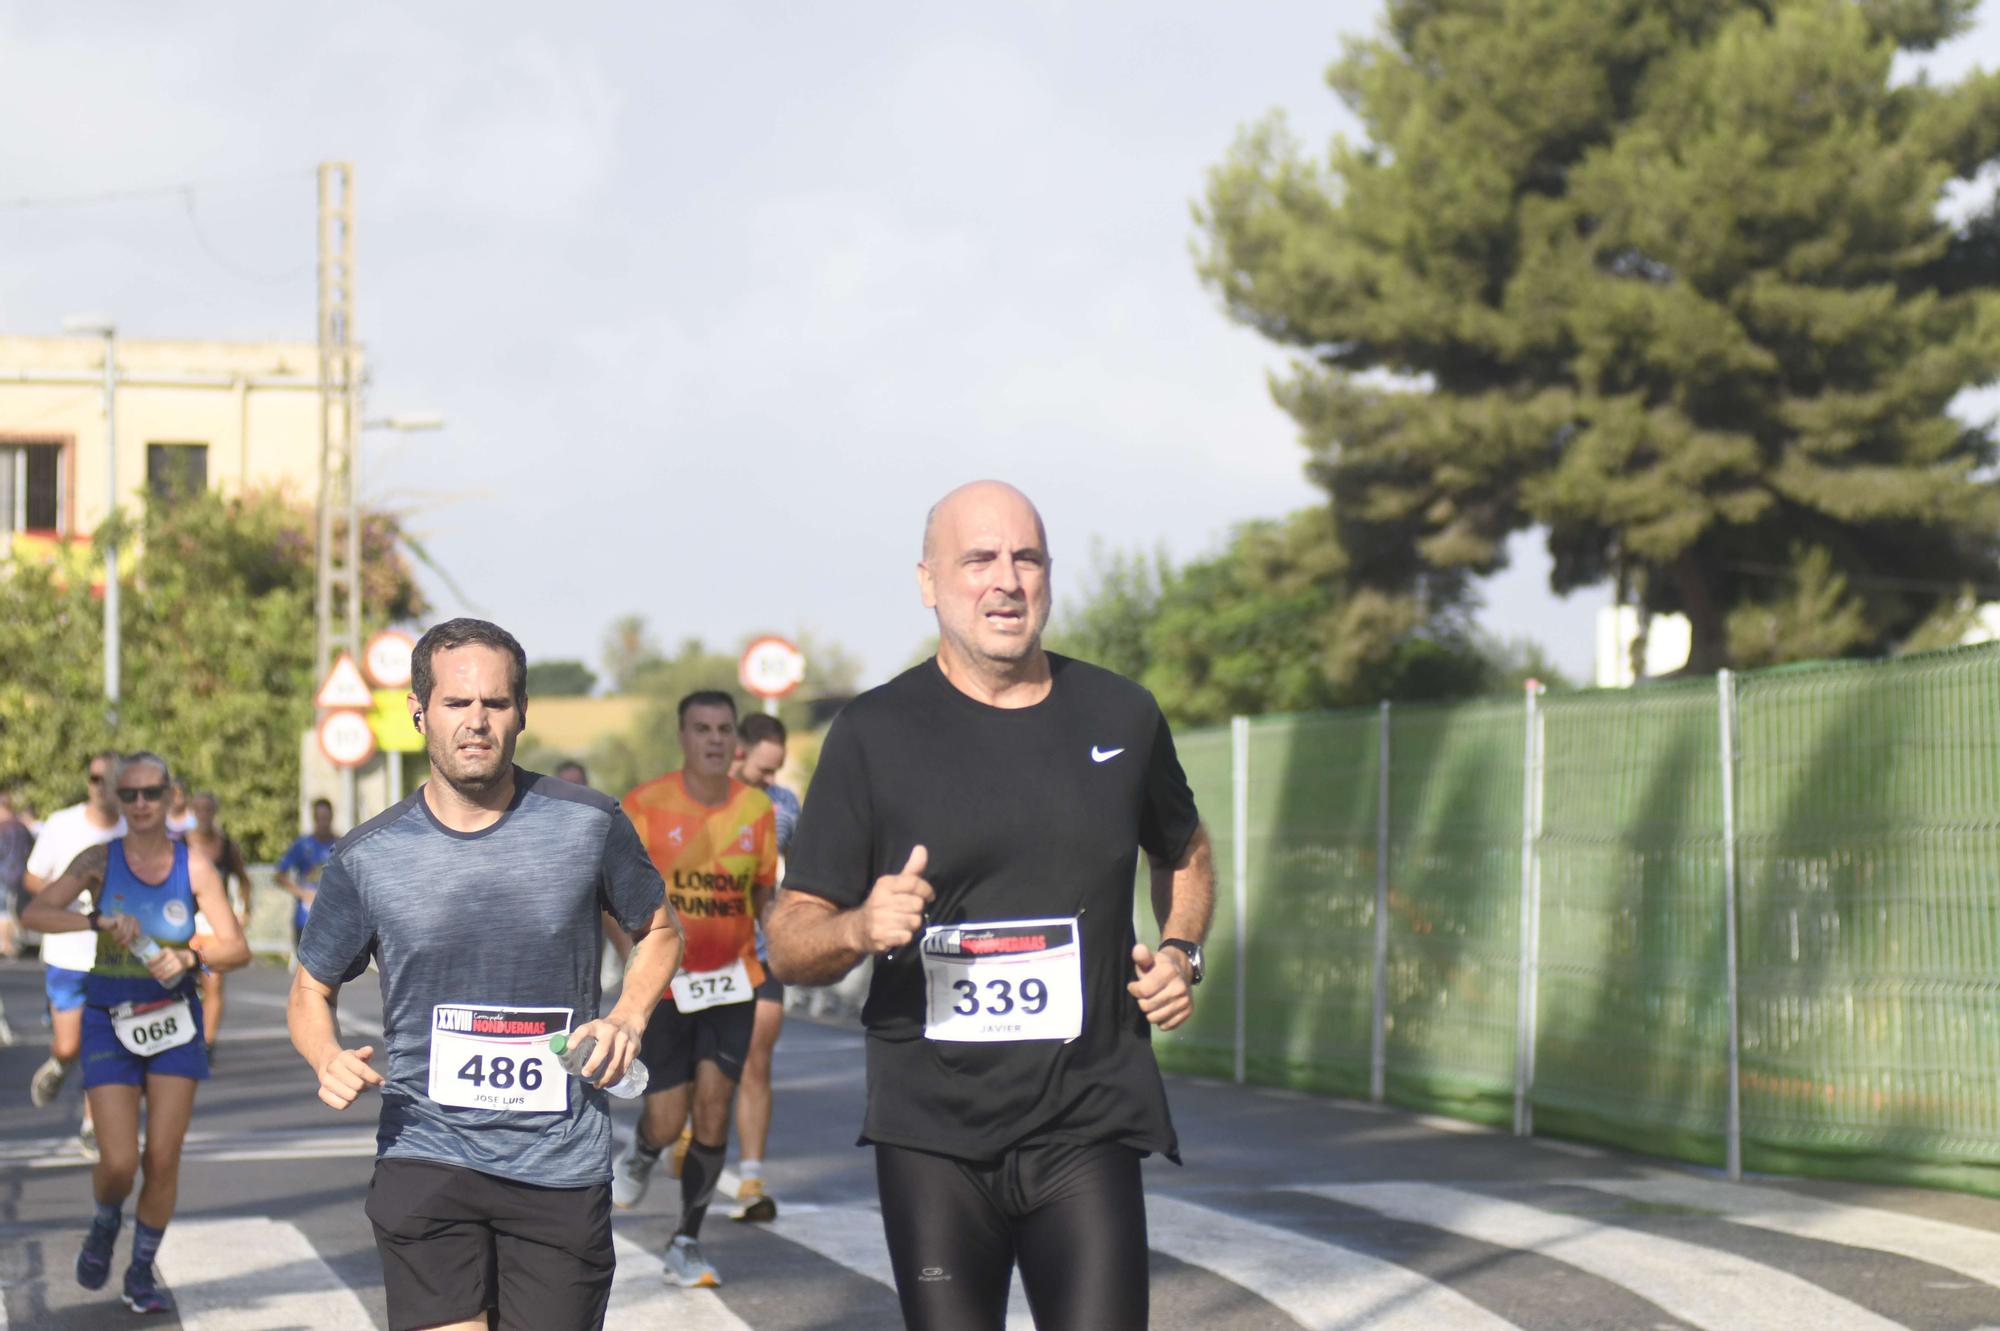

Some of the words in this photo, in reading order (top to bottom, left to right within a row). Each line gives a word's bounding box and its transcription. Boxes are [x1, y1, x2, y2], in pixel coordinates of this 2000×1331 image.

[690, 975, 736, 999] 572
[952, 978, 1048, 1016] 339
[133, 1017, 178, 1045] 068
[438, 1009, 472, 1031] XXVIII
[473, 1019, 546, 1034] NONDUERMAS
[979, 1024, 1021, 1033] JAVIER
[457, 1054, 543, 1091] 486
[474, 1094, 499, 1103] JOSE
[503, 1097, 525, 1105] LUIS
